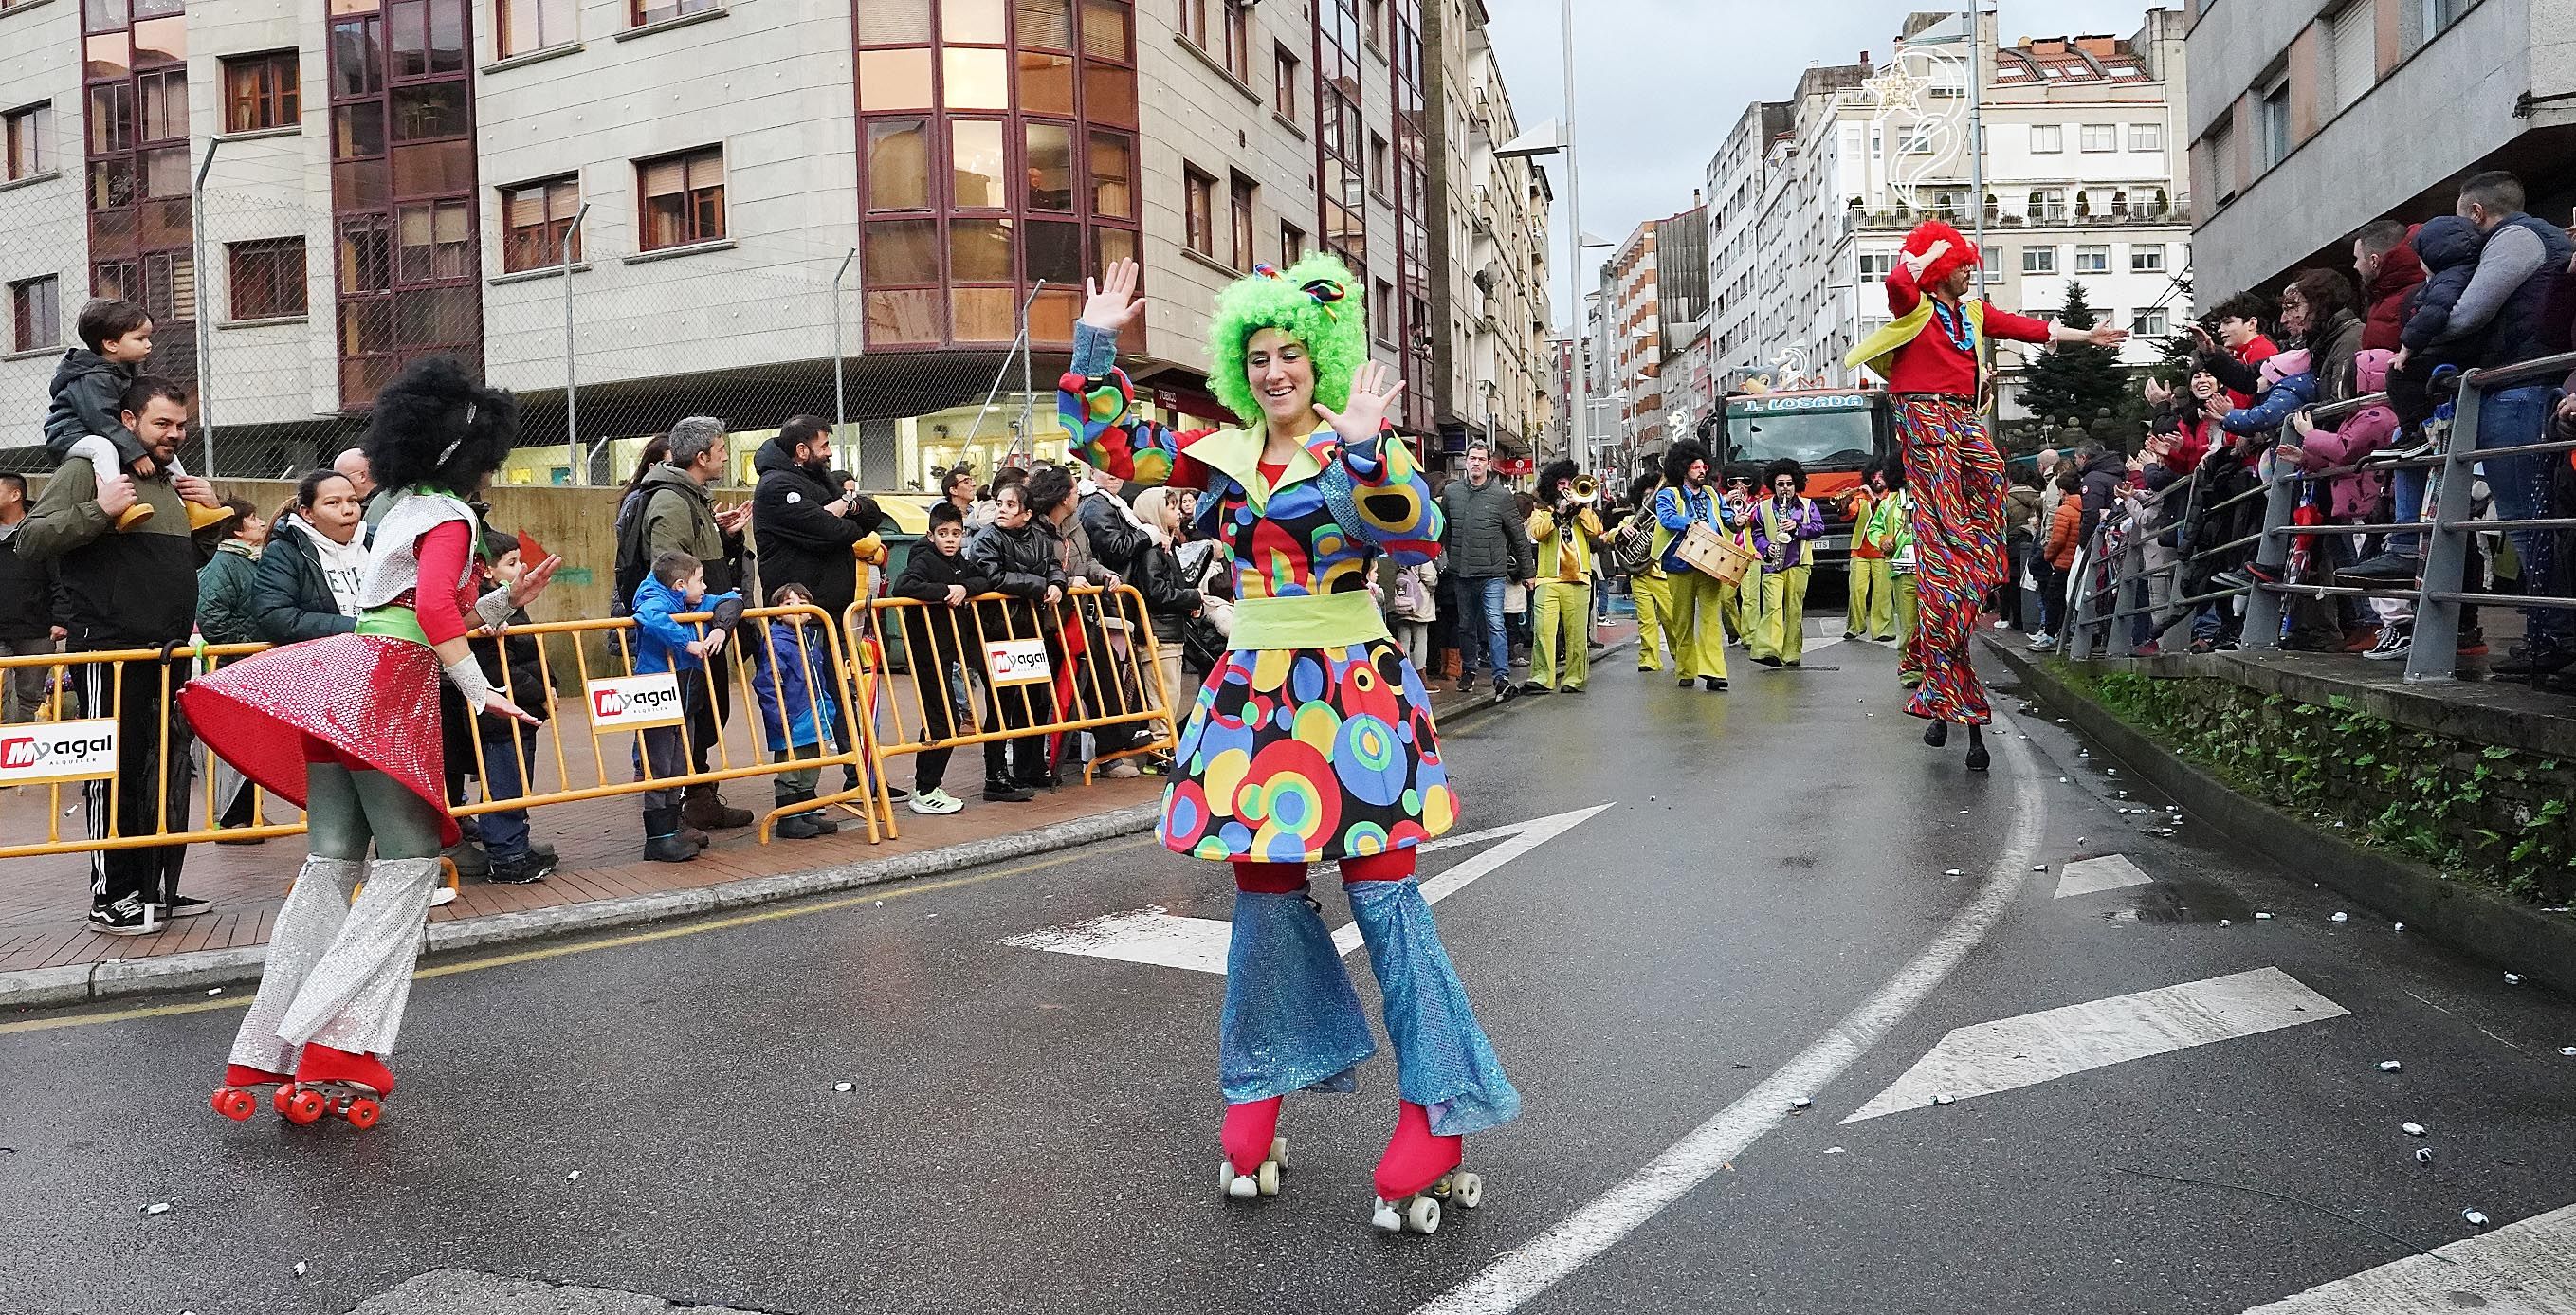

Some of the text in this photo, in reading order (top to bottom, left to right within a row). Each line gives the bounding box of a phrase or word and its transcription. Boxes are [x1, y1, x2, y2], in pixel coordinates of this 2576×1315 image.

[1744, 394, 1864, 411] J. LOSADA
[993, 652, 1046, 672] Myagal
[597, 686, 676, 714] Myagal
[3, 735, 112, 764] Myagal
